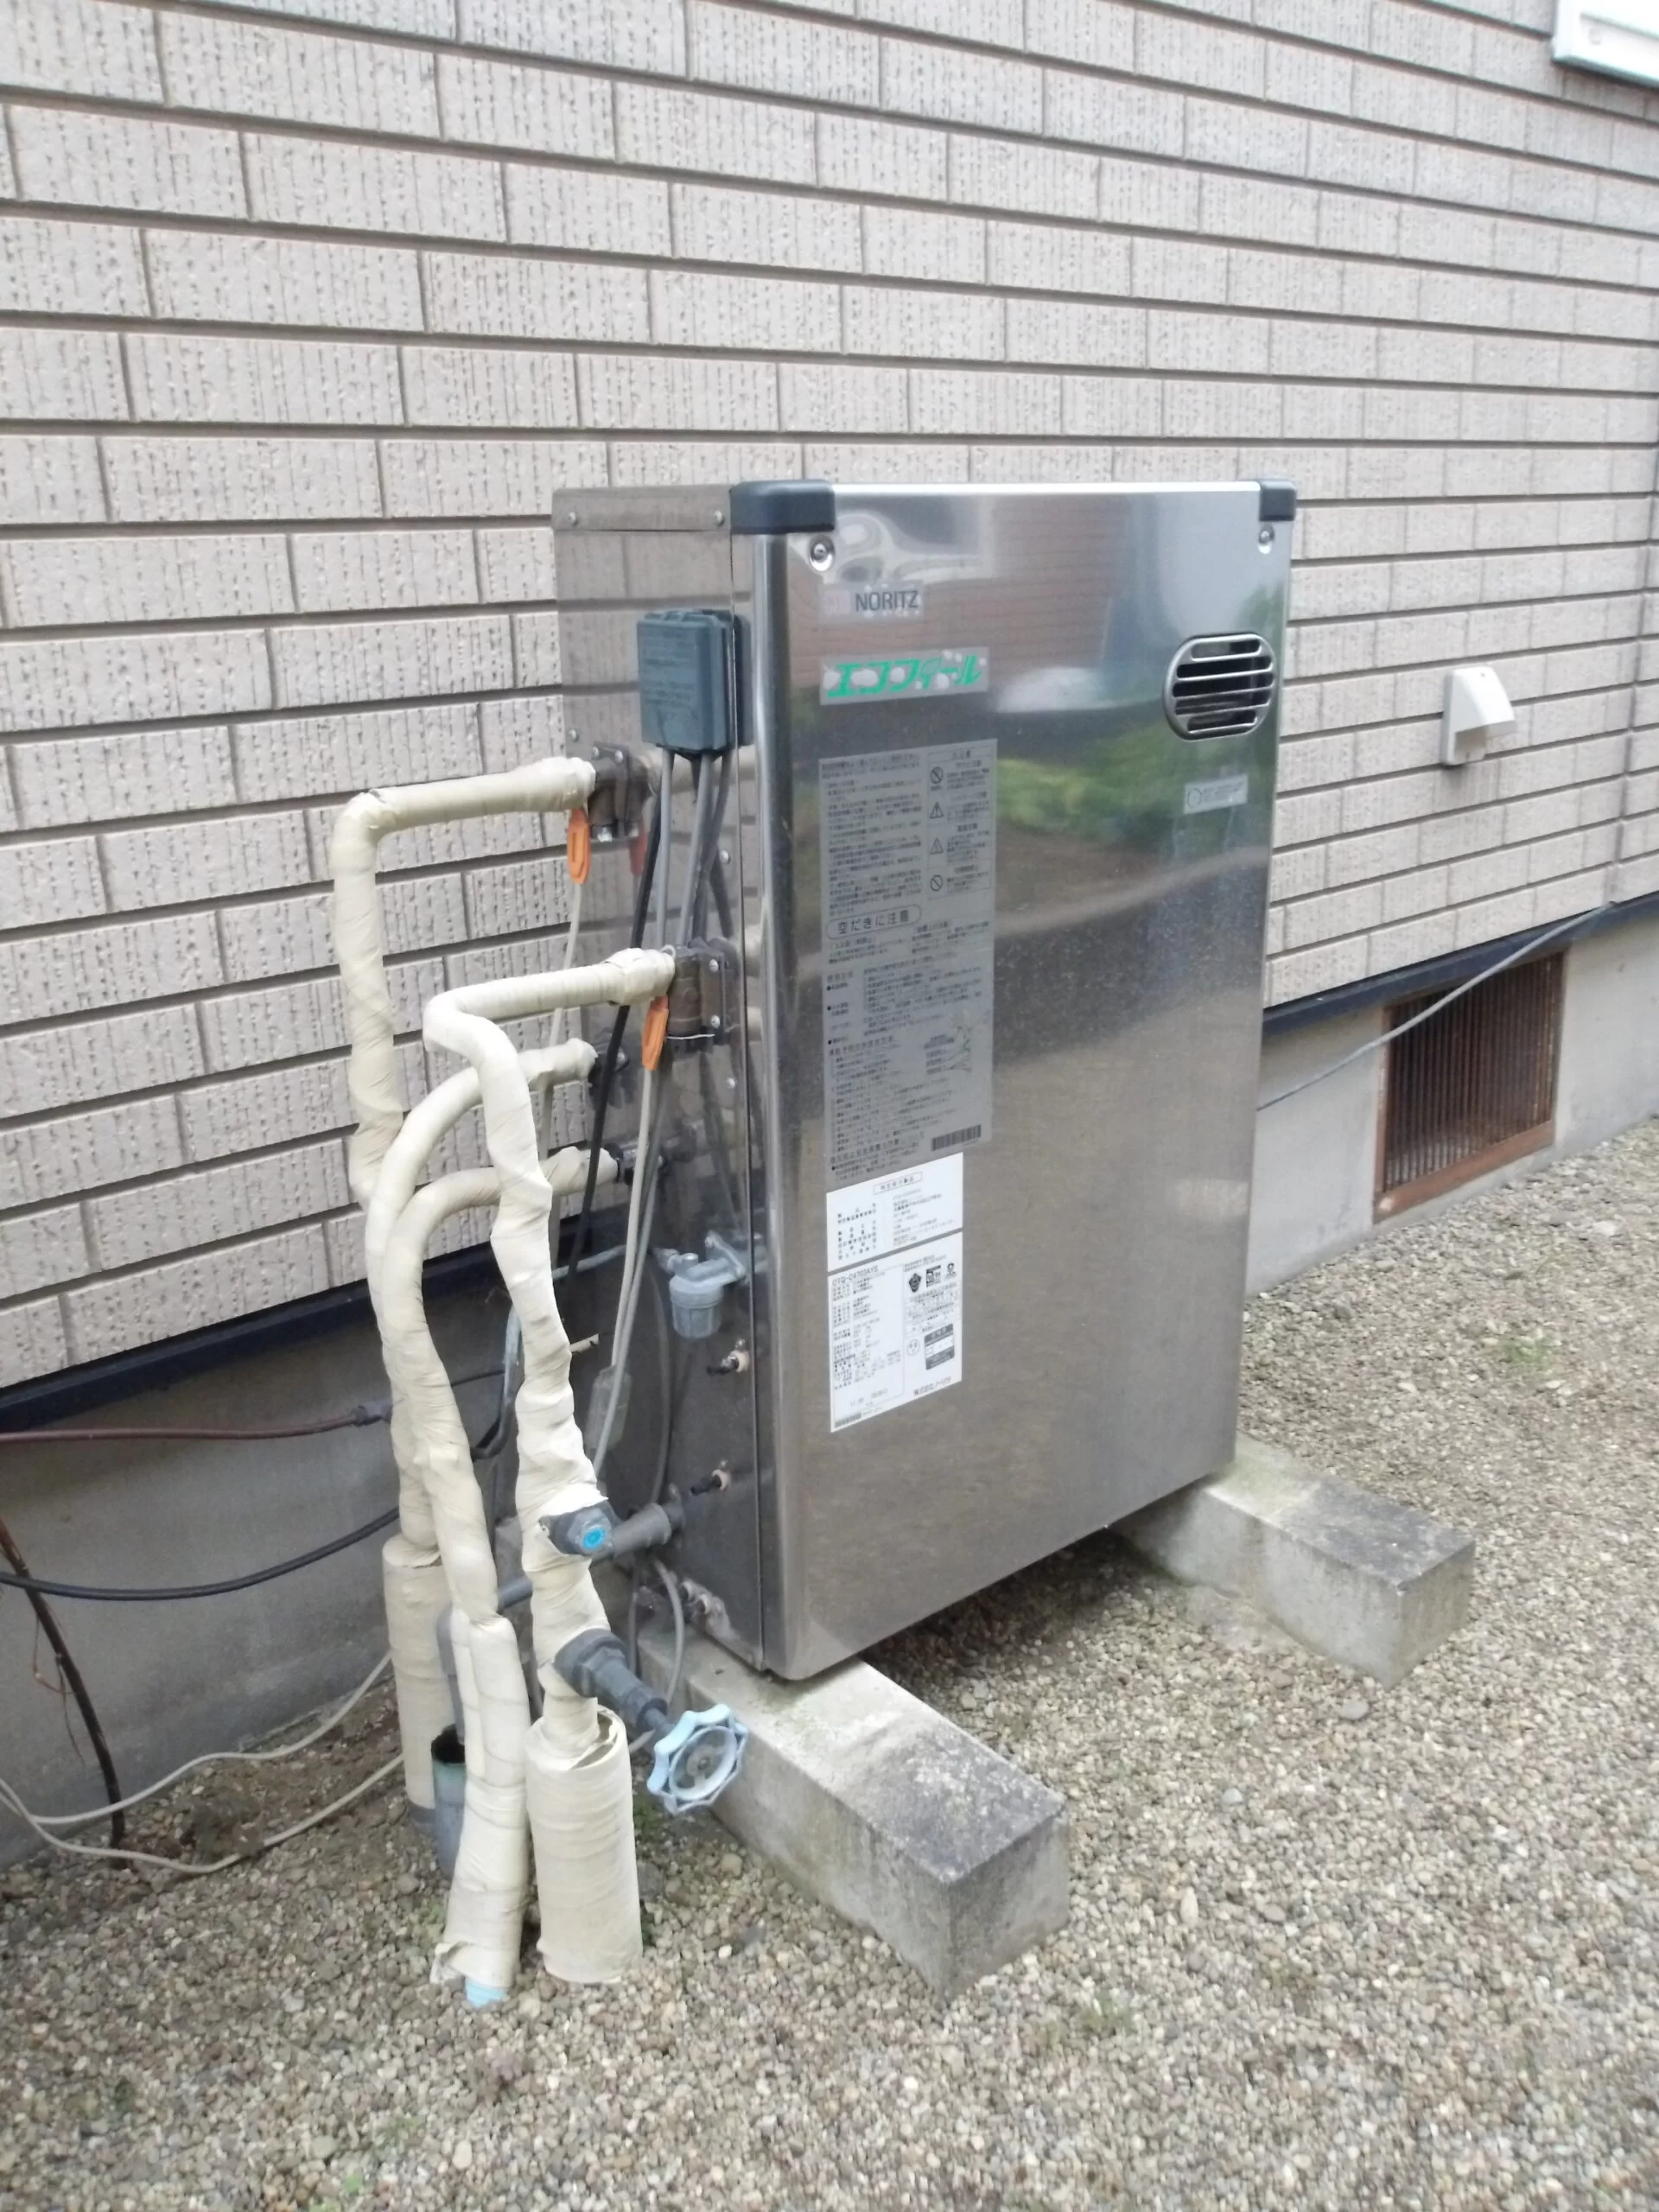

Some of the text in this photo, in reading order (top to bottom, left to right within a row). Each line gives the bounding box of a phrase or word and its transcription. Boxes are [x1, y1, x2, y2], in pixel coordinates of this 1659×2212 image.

[855, 590, 919, 612] NORITZ
[827, 655, 982, 697] エコフィール
